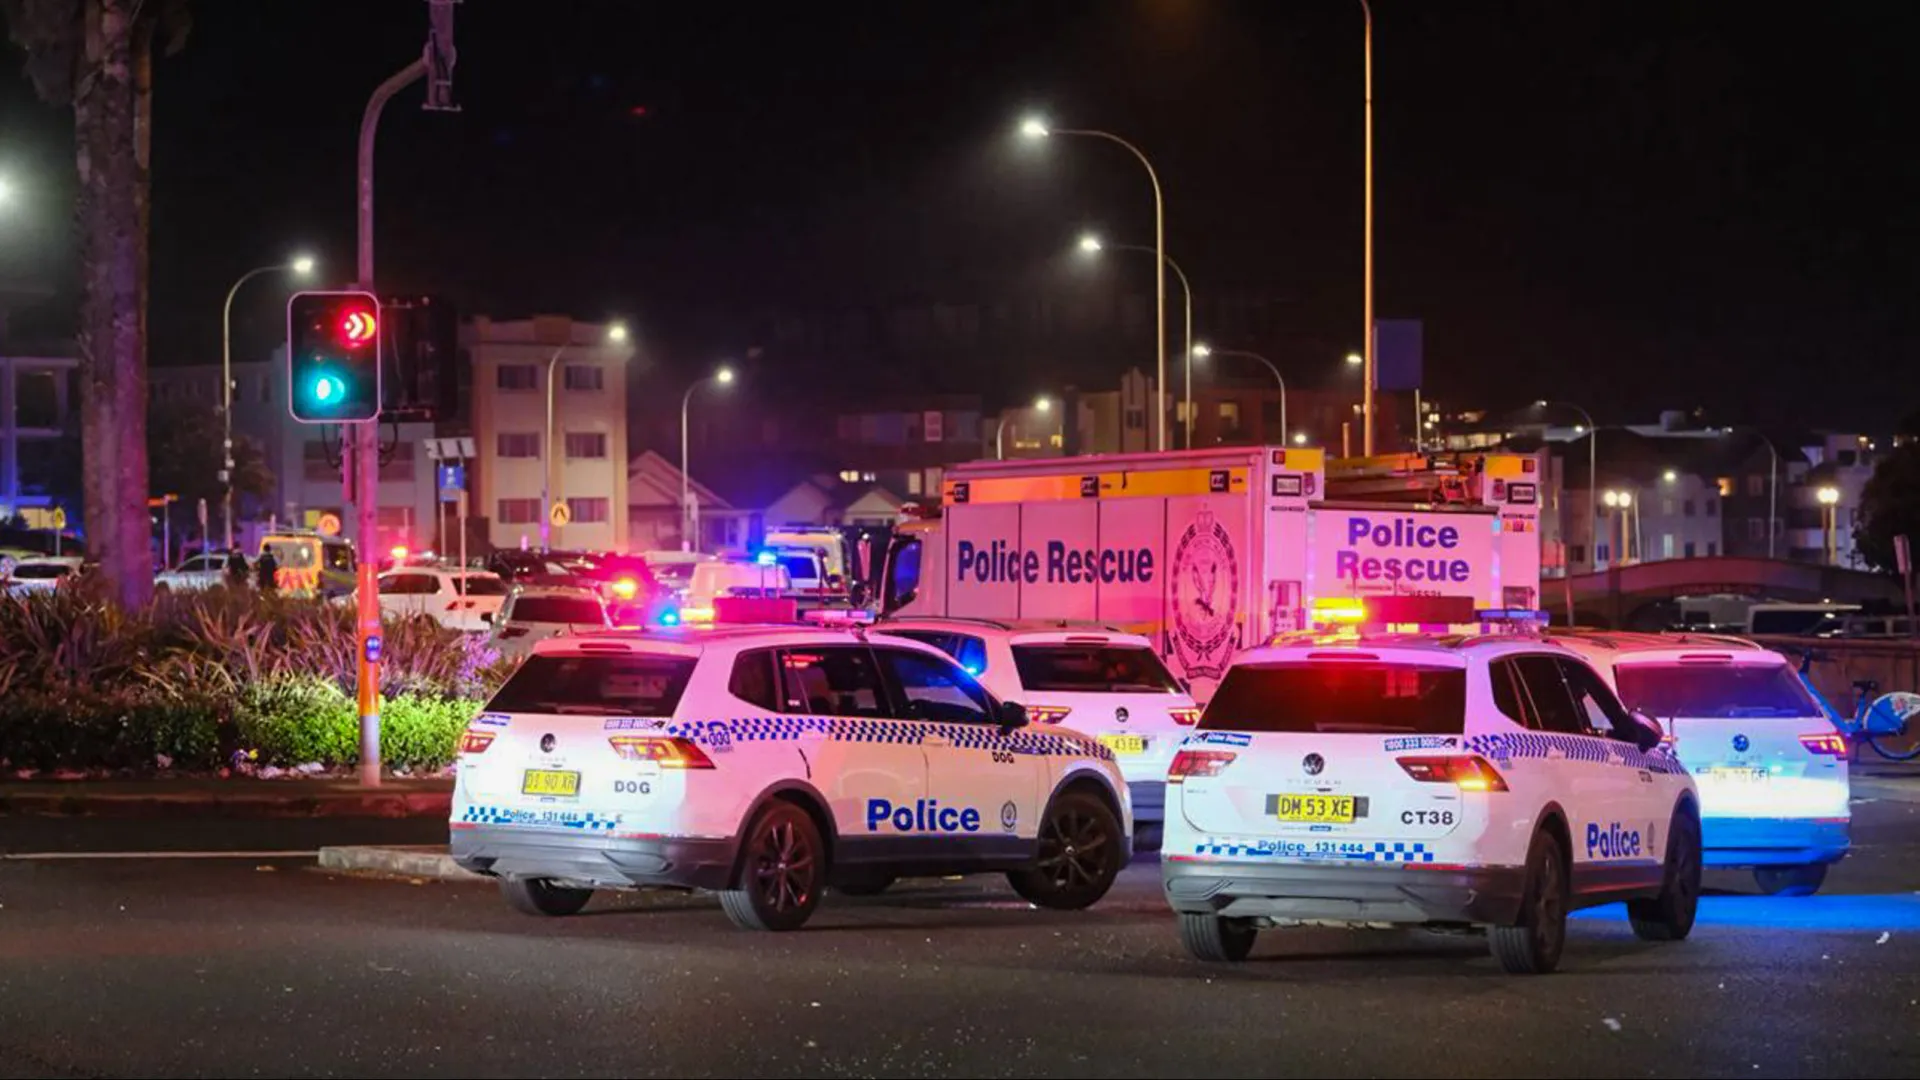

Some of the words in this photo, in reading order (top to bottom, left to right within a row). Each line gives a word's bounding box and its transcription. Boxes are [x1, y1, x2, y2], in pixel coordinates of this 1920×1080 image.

[1348, 517, 1459, 548] Police
[958, 540, 1039, 583] Police
[1047, 541, 1153, 583] Rescue
[1337, 550, 1470, 581] Rescue
[614, 780, 651, 794] DOG
[503, 809, 536, 819] Police
[867, 798, 980, 832] Police
[1281, 797, 1302, 815] DM
[1306, 798, 1326, 816] 53
[1332, 799, 1351, 817] XE
[1401, 811, 1453, 825] CT38
[1258, 840, 1305, 851] Police
[1587, 822, 1640, 858] Police
